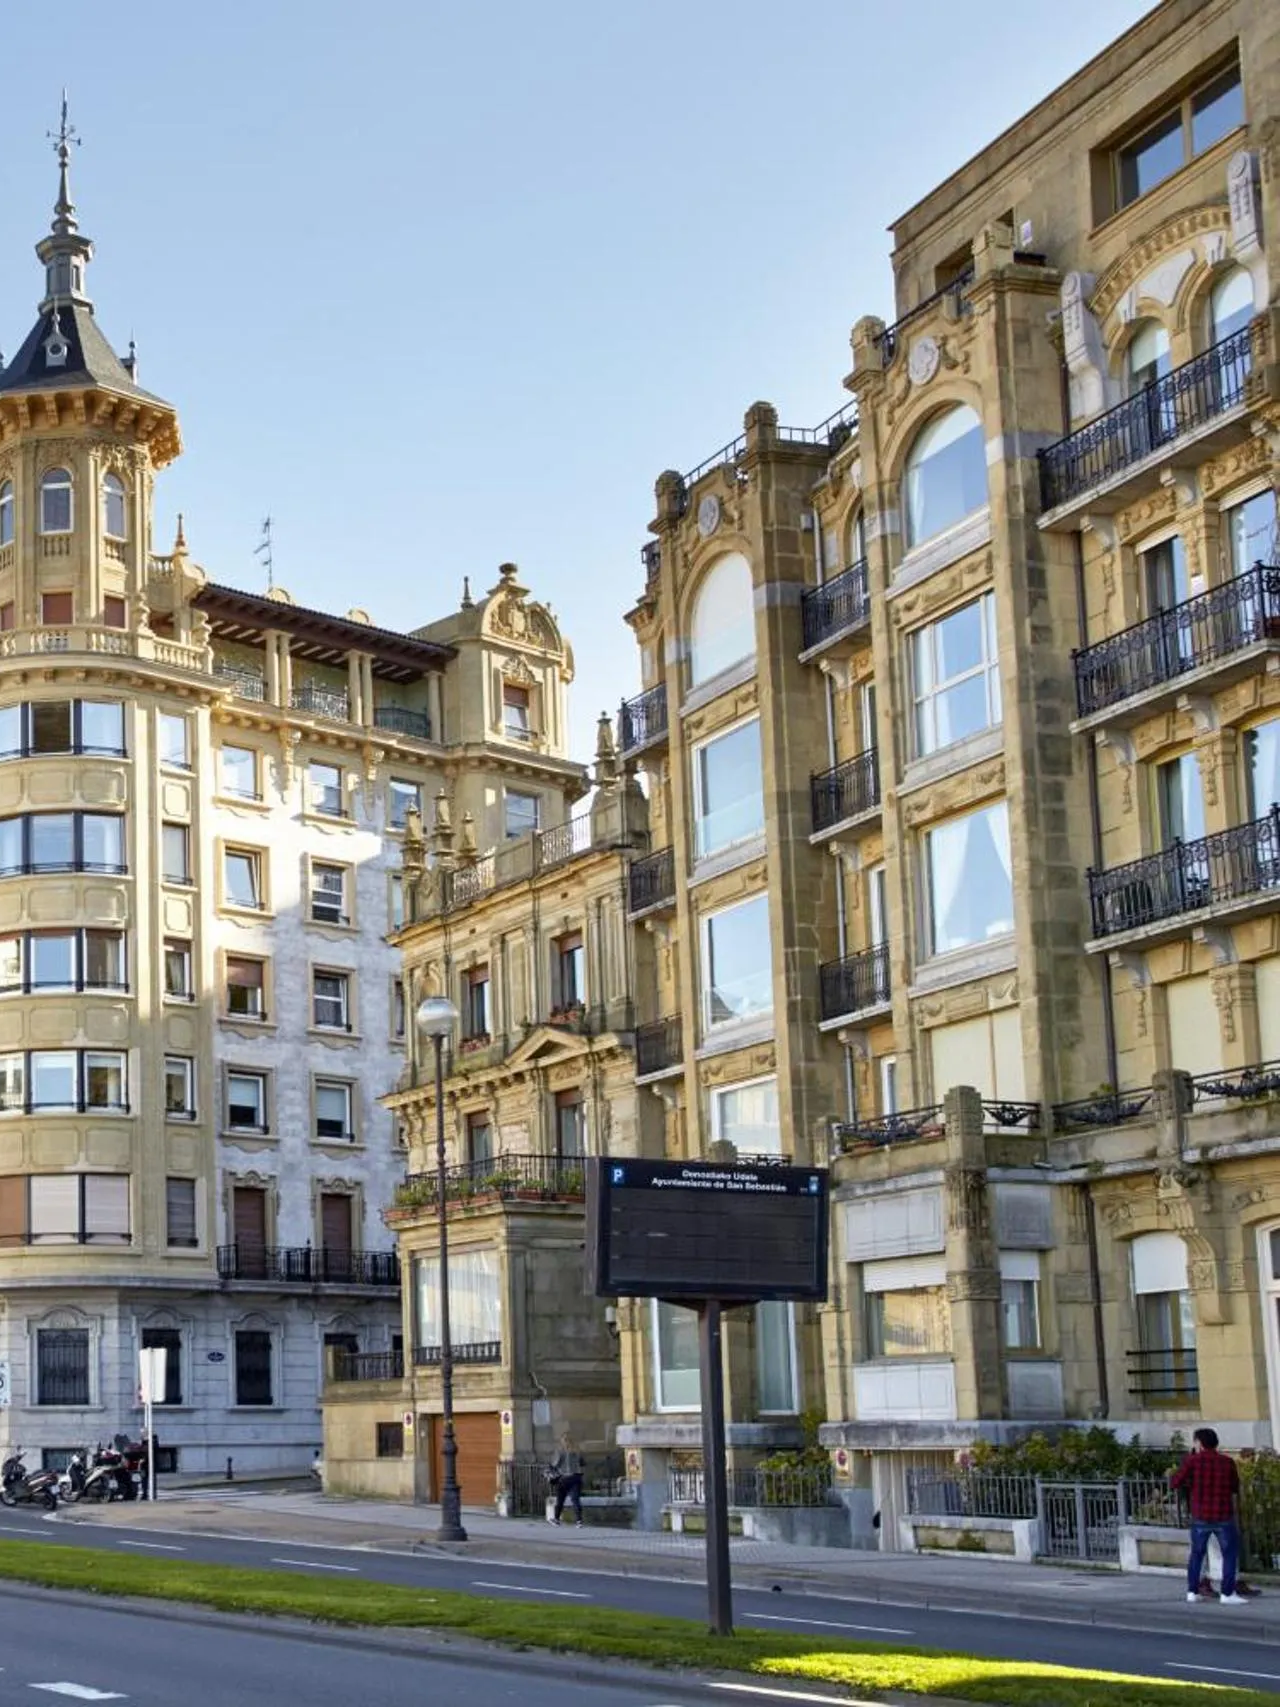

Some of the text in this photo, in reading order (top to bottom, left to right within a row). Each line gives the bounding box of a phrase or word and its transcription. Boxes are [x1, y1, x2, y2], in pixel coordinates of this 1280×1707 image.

[613, 1168, 623, 1182] P
[652, 1178, 712, 1188] Ayuntamiento
[713, 1181, 724, 1189] de
[727, 1181, 743, 1190] San
